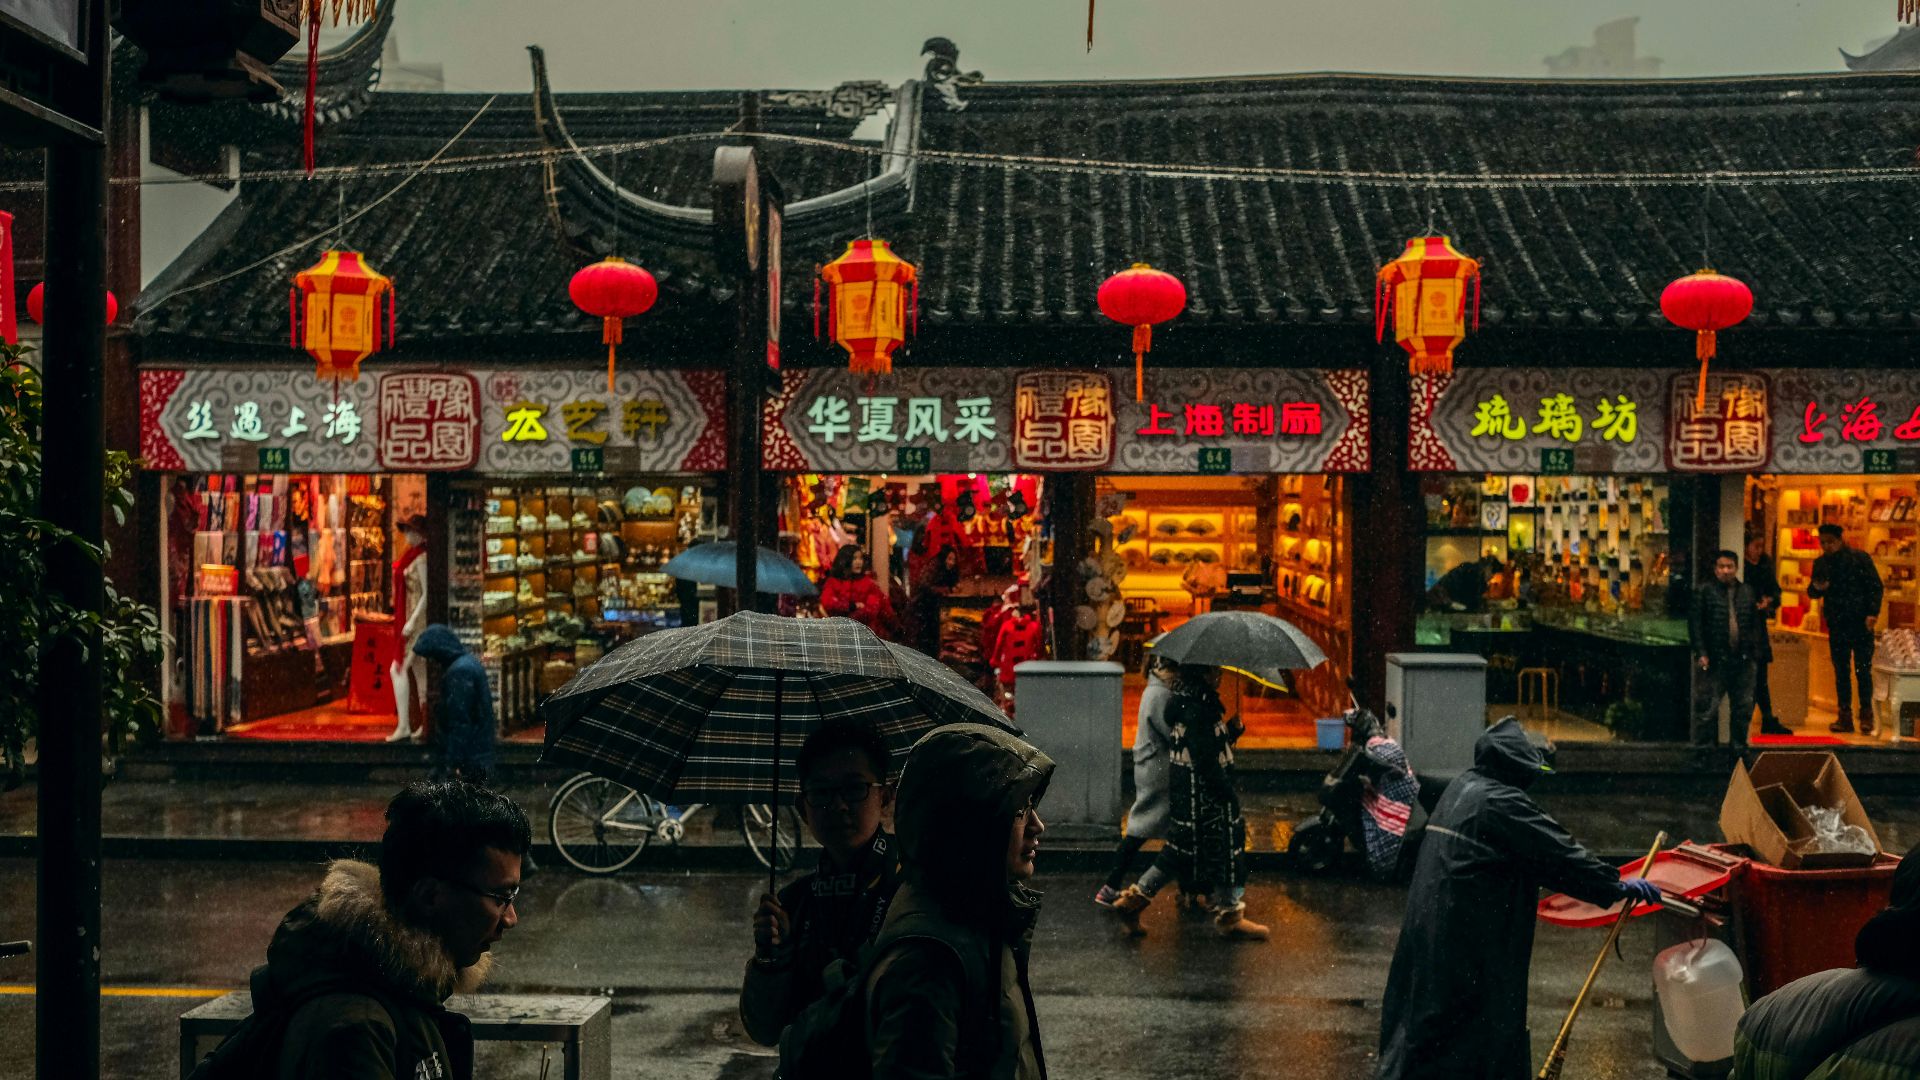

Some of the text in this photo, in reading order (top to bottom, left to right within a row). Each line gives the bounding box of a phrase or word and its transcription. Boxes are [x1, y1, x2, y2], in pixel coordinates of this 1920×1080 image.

[182, 400, 362, 445] 丝遇上海
[807, 395, 997, 443] 华夏风采
[1136, 401, 1322, 436] 上海制扇
[1471, 391, 1638, 443] 琉璃坊
[905, 449, 923, 464] 64
[1206, 450, 1223, 465] 64
[1549, 450, 1567, 465] 62
[1871, 451, 1889, 466] 62
[869, 896, 887, 934] SONY
